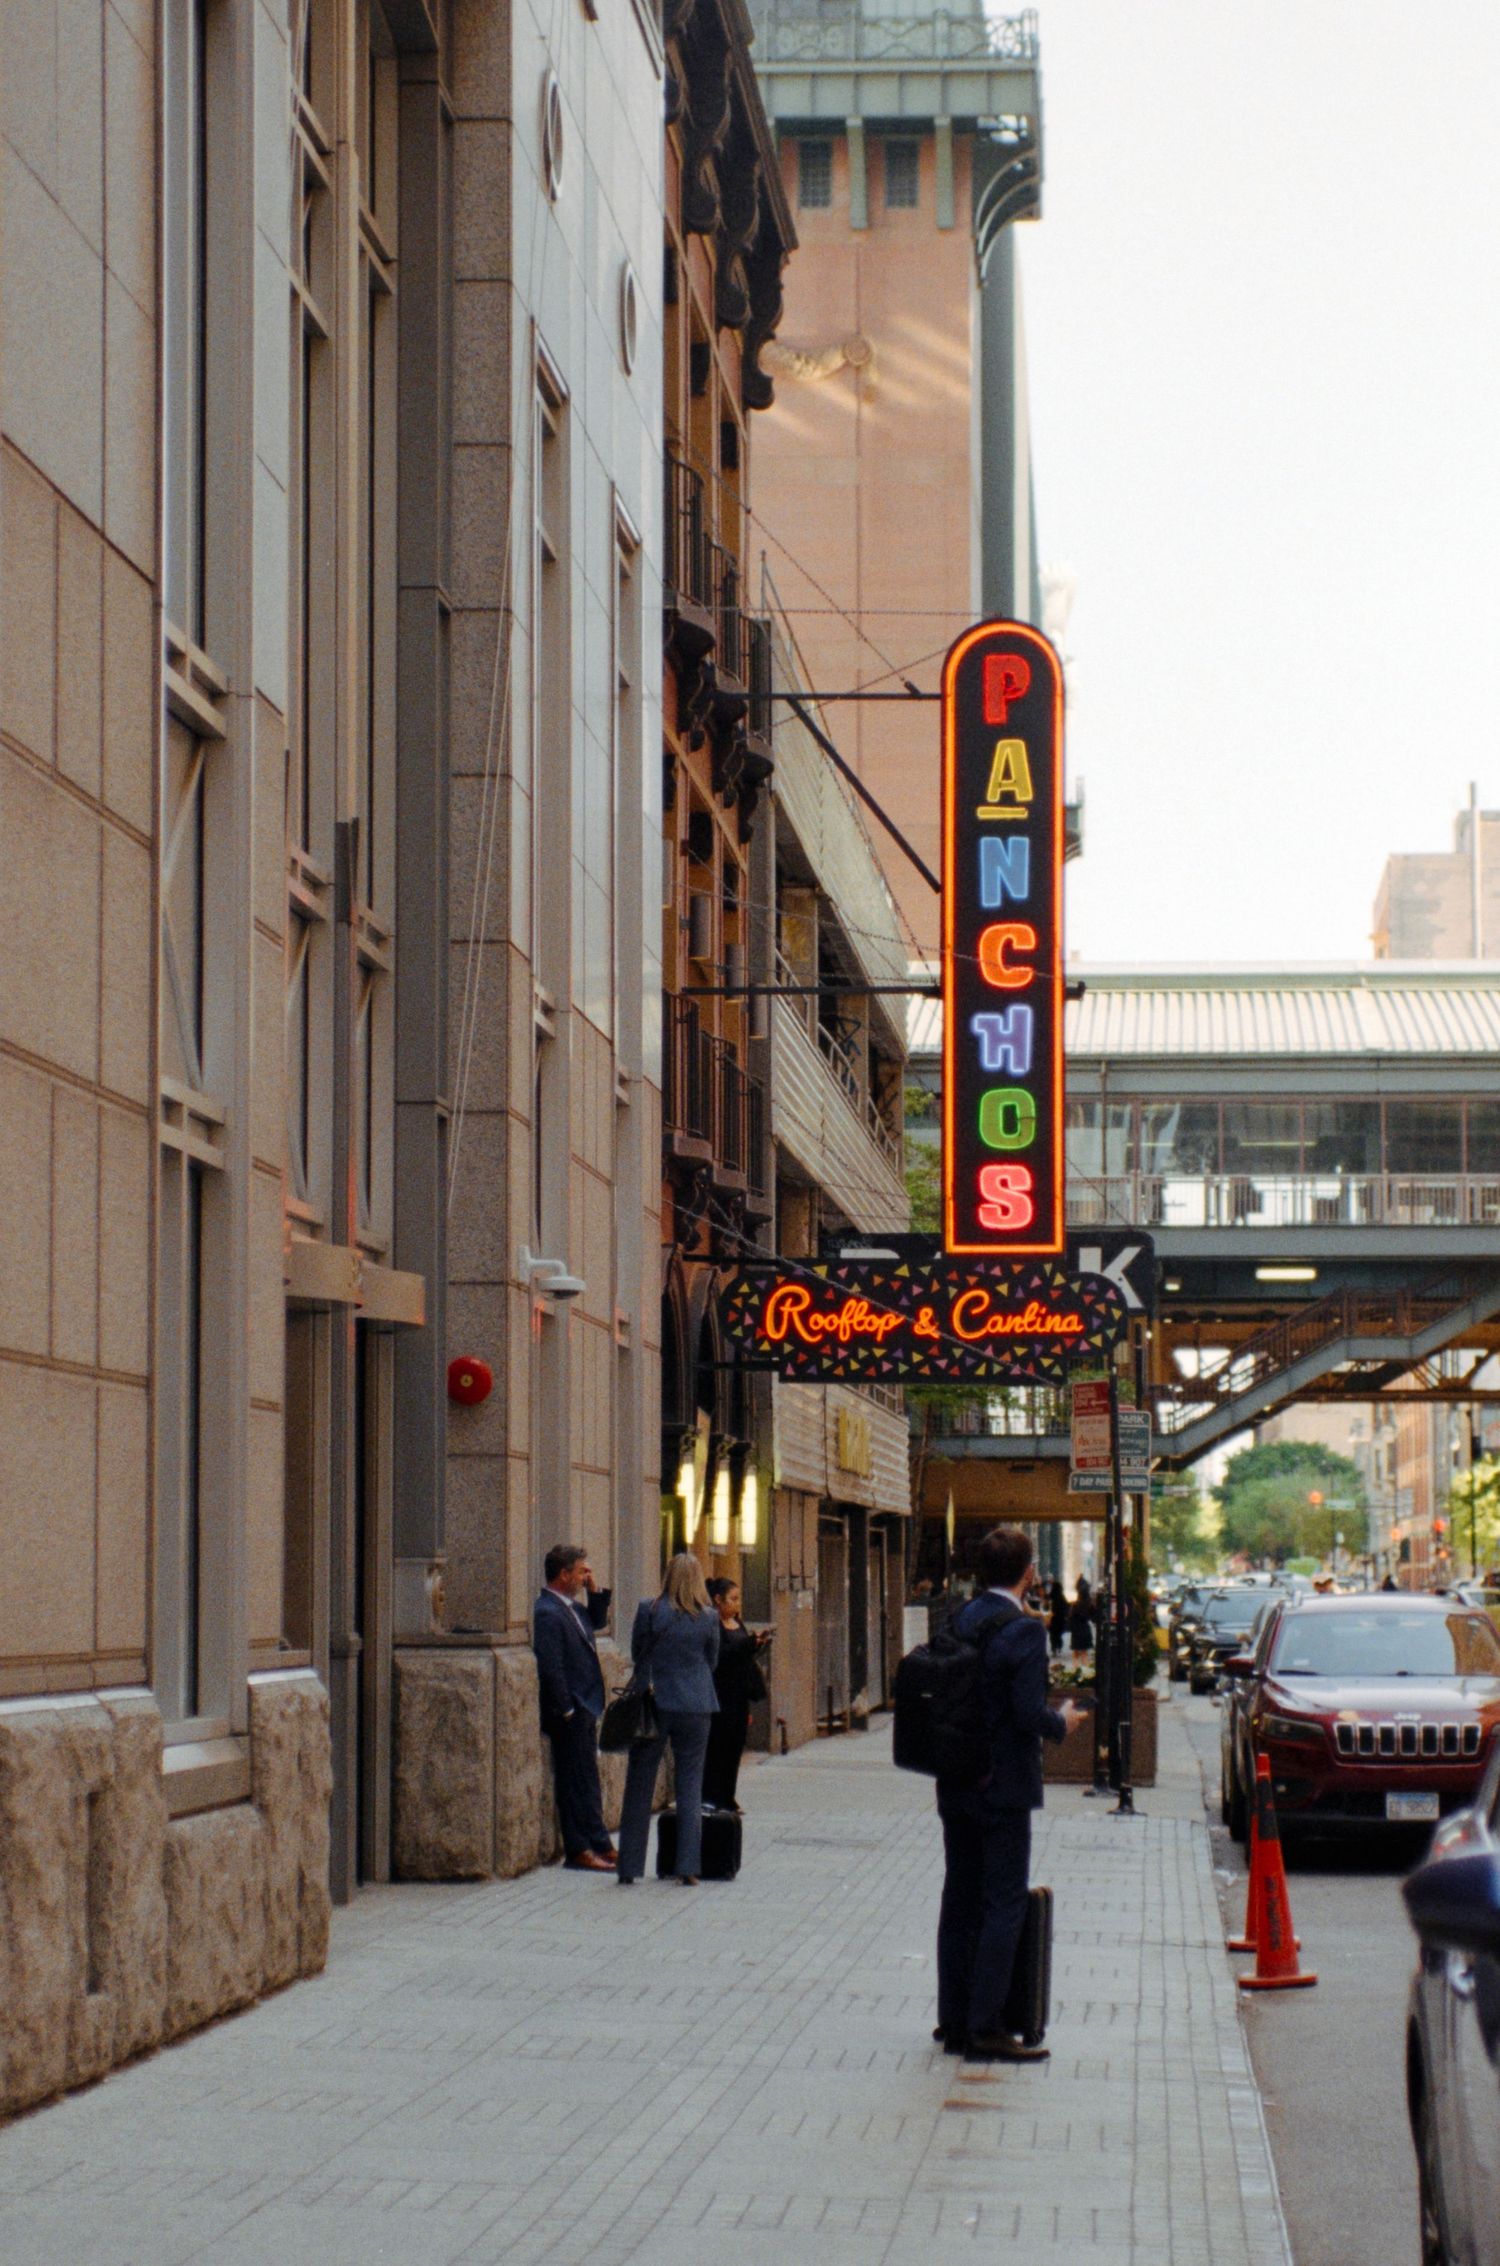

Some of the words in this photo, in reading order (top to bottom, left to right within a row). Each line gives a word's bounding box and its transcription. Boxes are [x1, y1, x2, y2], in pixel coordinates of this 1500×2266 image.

[972, 652, 1036, 1230] PANCHOS
[764, 1284, 905, 1342] Rooftop
[914, 1307, 940, 1338] &
[952, 1288, 1083, 1340] Cantina
[1120, 1478, 1147, 1487] ARKING
